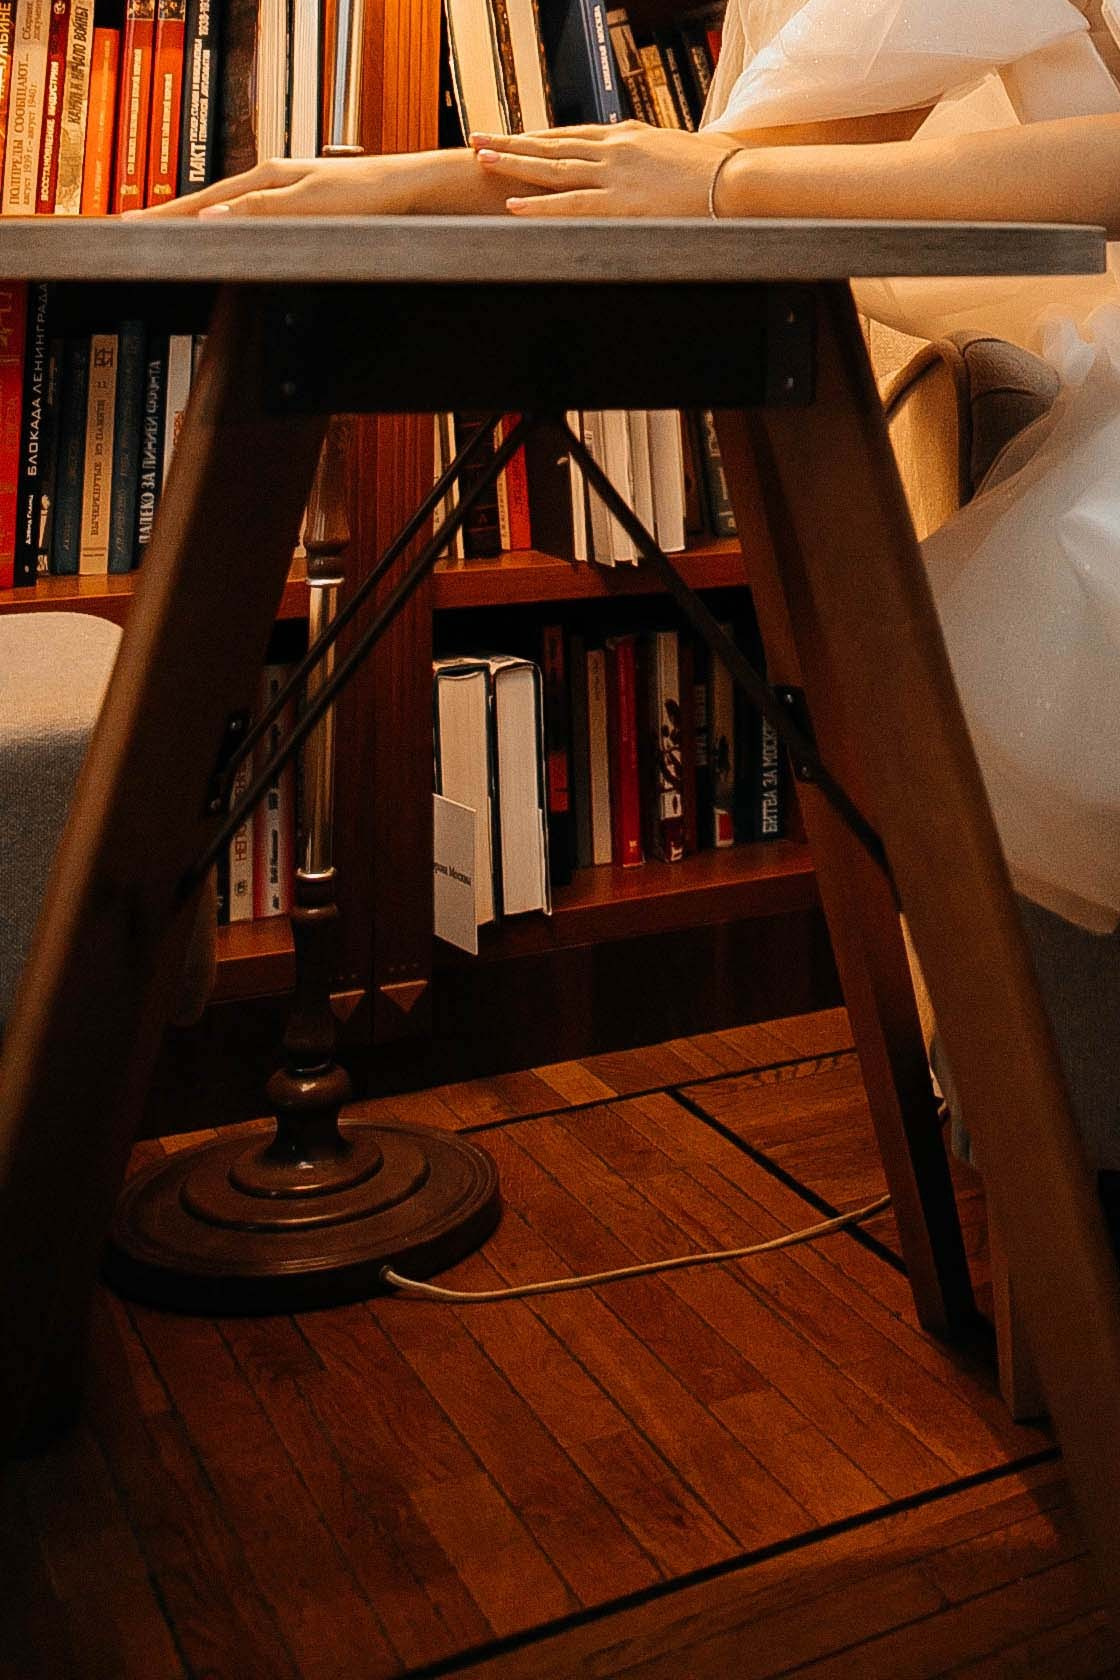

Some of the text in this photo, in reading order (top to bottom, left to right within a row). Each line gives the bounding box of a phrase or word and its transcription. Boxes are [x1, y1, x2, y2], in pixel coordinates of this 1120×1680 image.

[21, 2, 34, 41] Сборник
[70, 6, 89, 43] ВОЙНЫ
[70, 44, 86, 82] НАЧАЛО
[40, 61, 59, 202] ВОССТАНОВЛЕНИЕ ИНДУСТРИИ
[9, 140, 24, 206] ПОЛПРЕДЫ
[22, 177, 32, 206] август
[27, 112, 37, 140] август
[189, 143, 206, 183] ПАКТ
[33, 282, 48, 395] ЛЕНИНГРАДА
[27, 398, 42, 477] БЛОКАДА
[141, 415, 159, 470] ЛИНИЕЙ
[91, 462, 103, 536] ВЫЧЕРКНУТЫЕ
[140, 472, 156, 490] ЗА
[138, 492, 156, 545] ДАЛЕКО
[762, 770, 777, 788] ЗА
[762, 790, 778, 834] БИТВА
